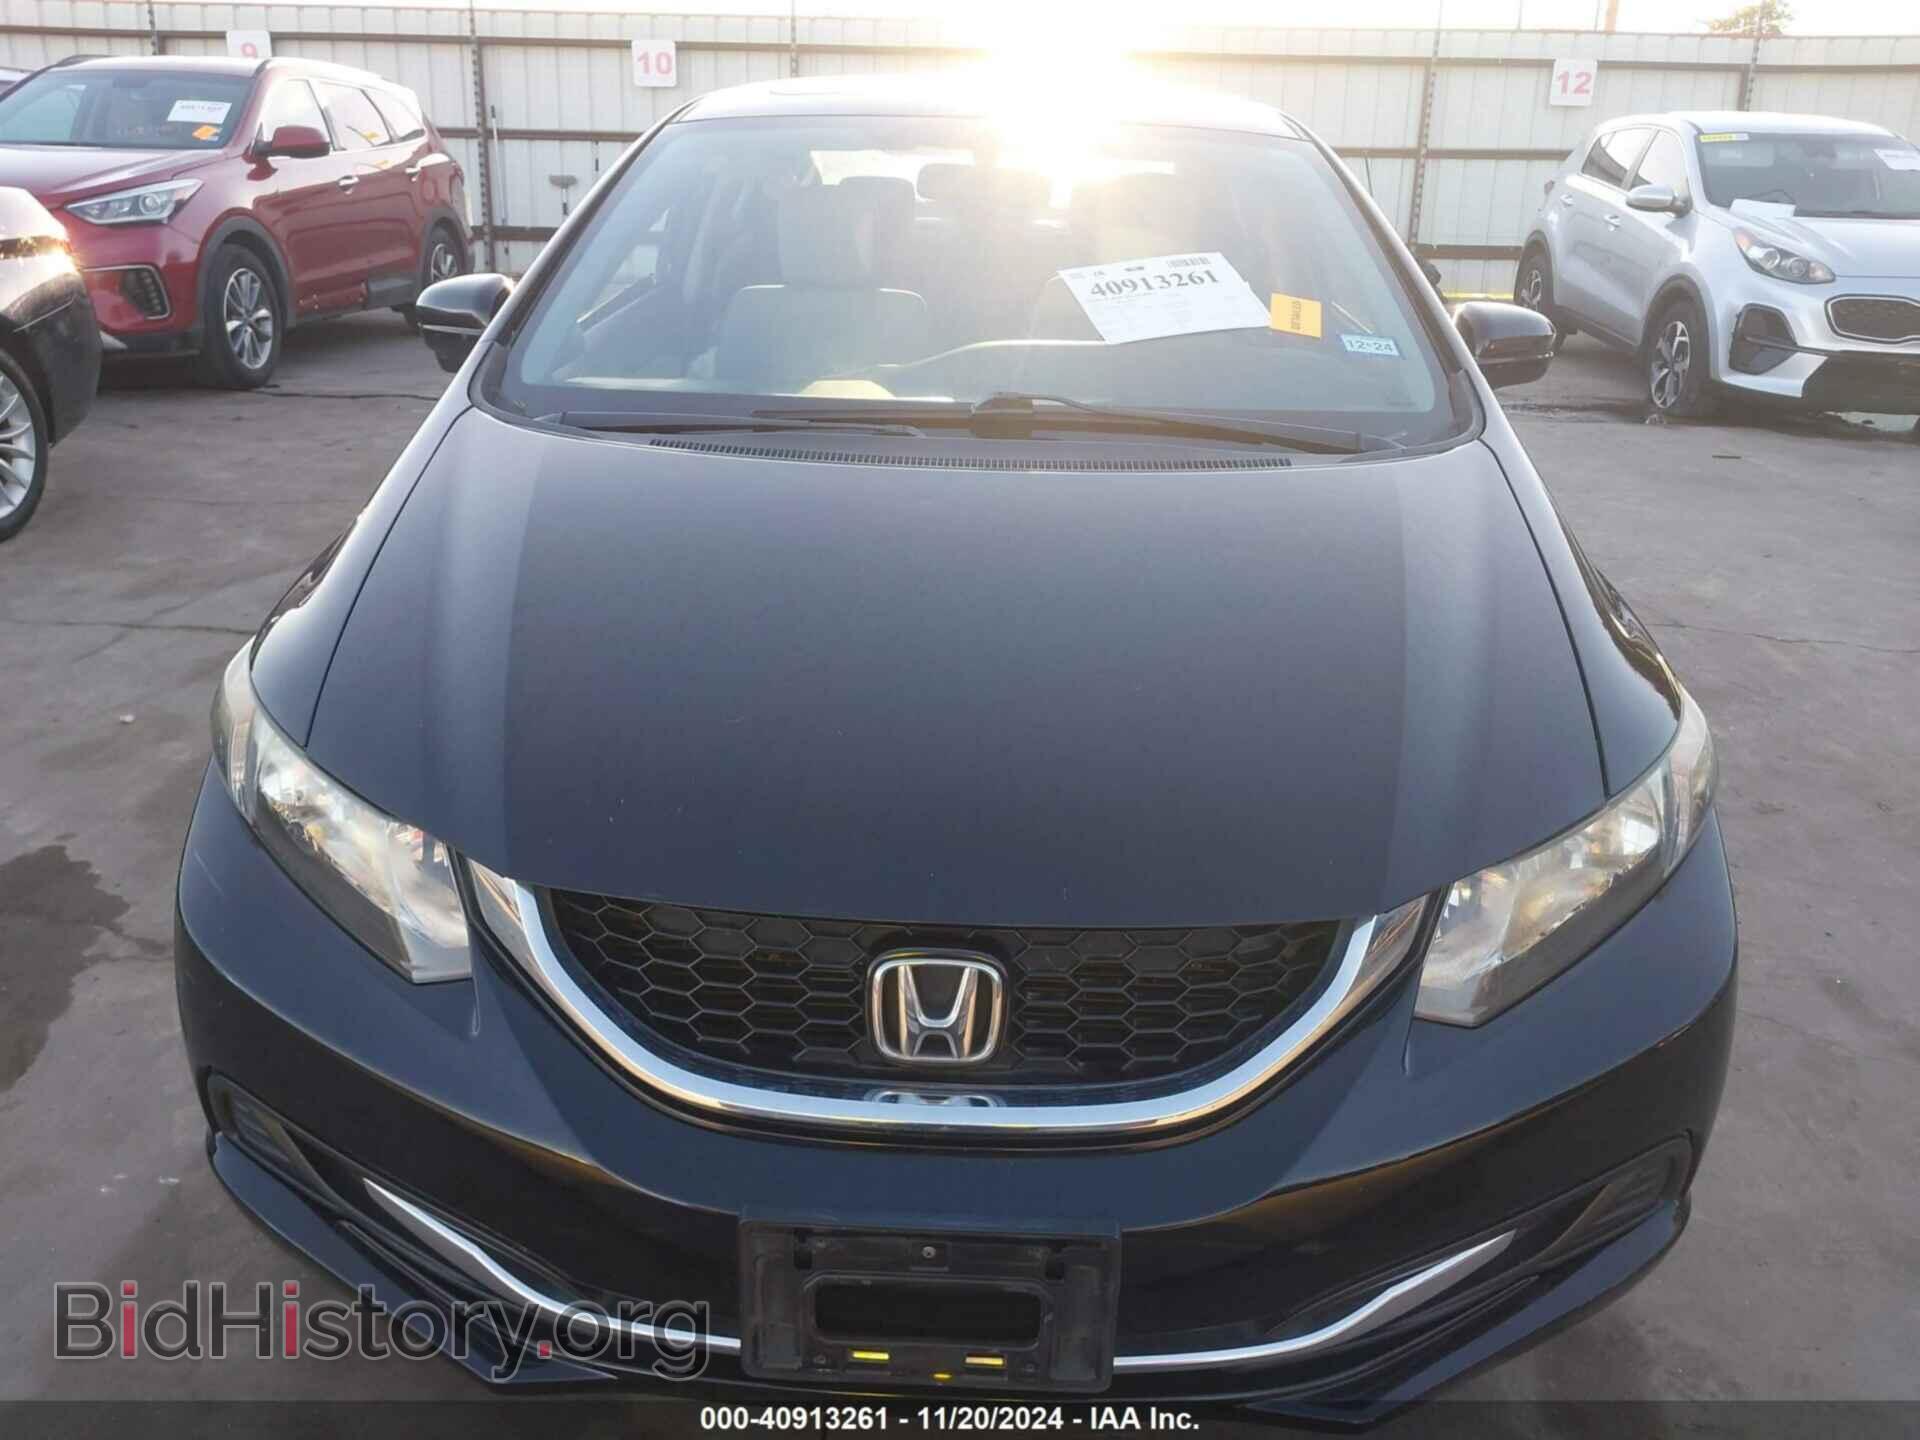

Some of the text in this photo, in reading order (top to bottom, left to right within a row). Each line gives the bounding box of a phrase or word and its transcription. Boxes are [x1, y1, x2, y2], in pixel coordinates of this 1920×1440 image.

[637, 51, 673, 75] 10
[1557, 70, 1592, 95] 12
[1090, 269, 1219, 297] 40913261
